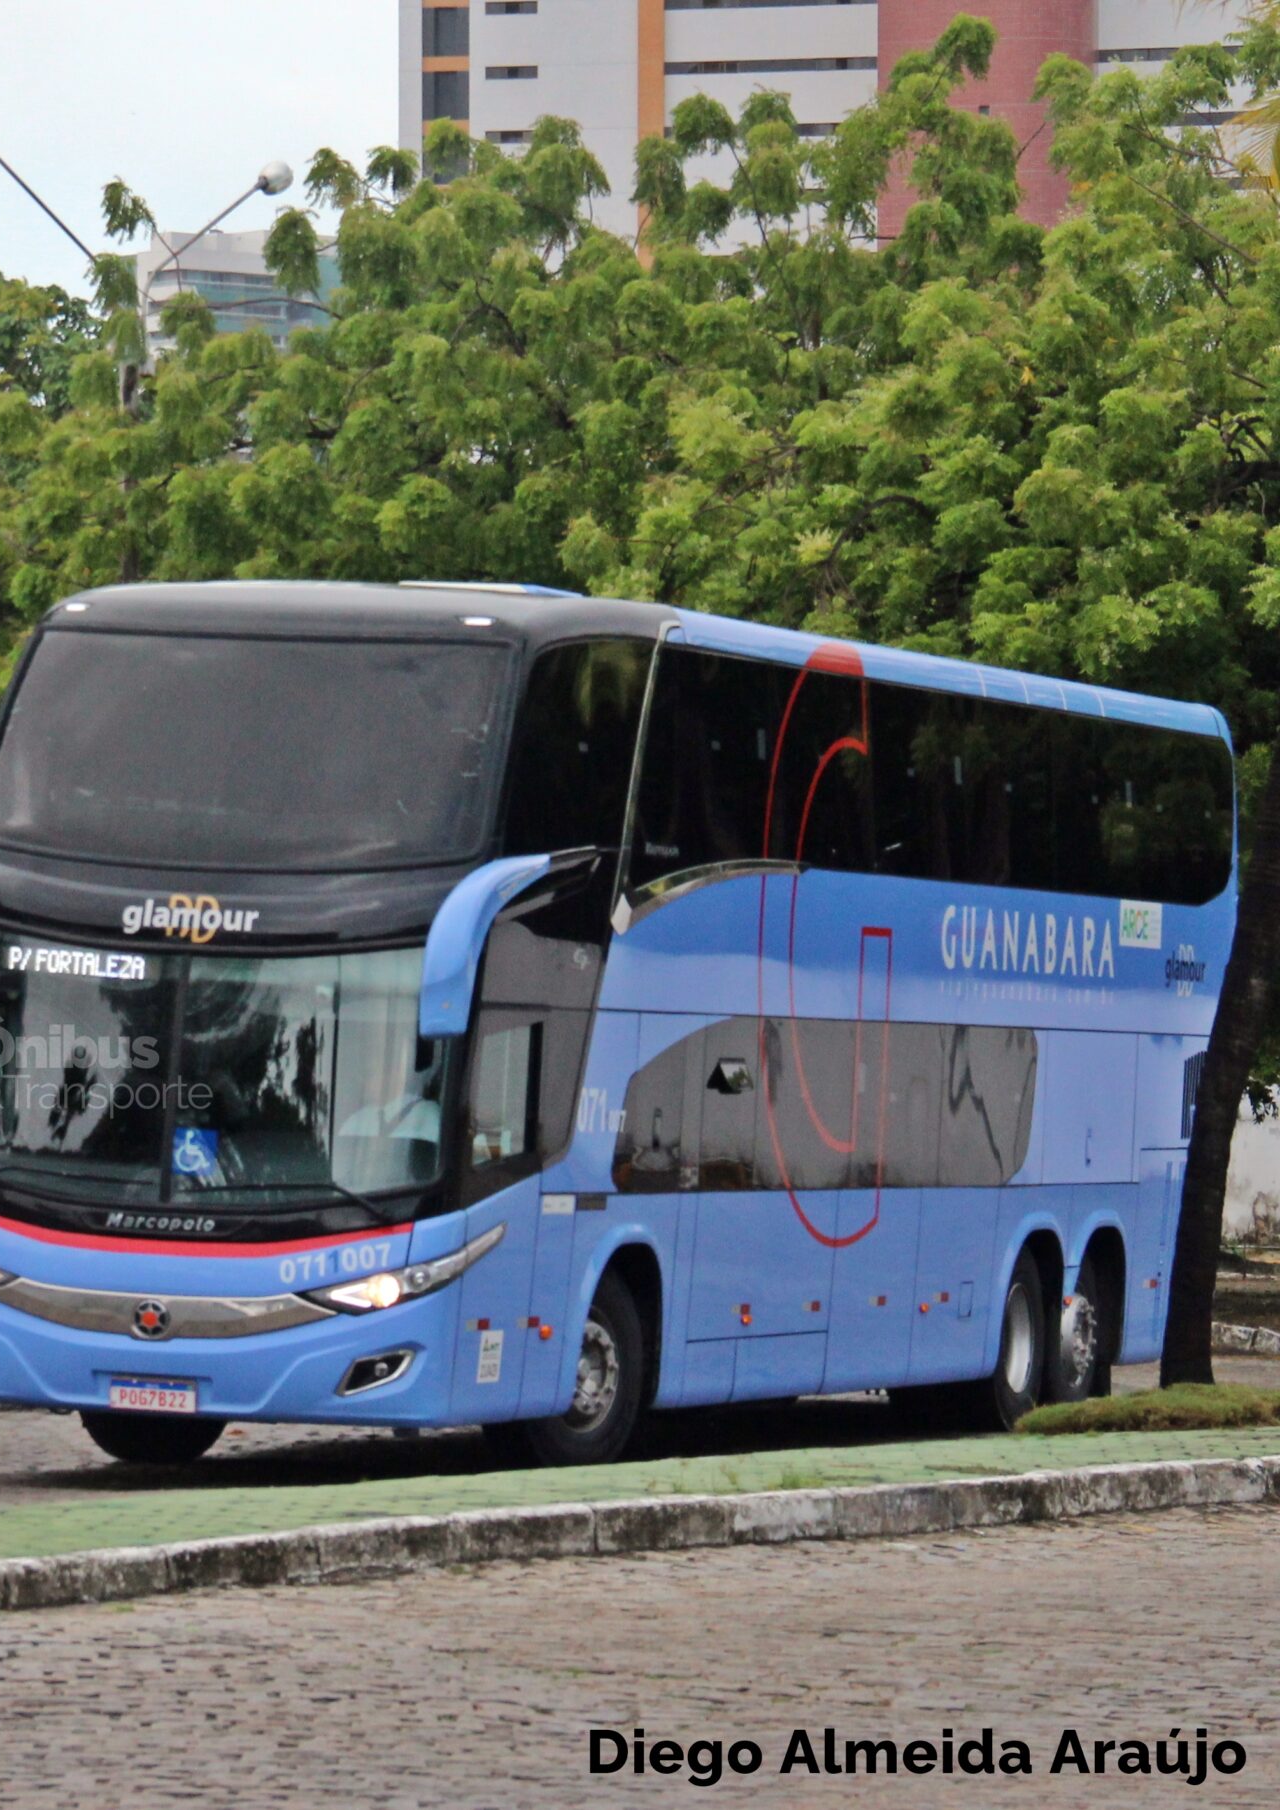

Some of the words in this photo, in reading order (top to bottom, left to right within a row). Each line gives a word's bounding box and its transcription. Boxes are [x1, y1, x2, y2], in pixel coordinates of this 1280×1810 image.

[122, 898, 260, 935] glamour
[941, 904, 1115, 979] GUANABARA
[35, 949, 146, 980] FORTALEZA
[1165, 949, 1206, 989] glamour
[106, 1213, 216, 1233] Marcopolo
